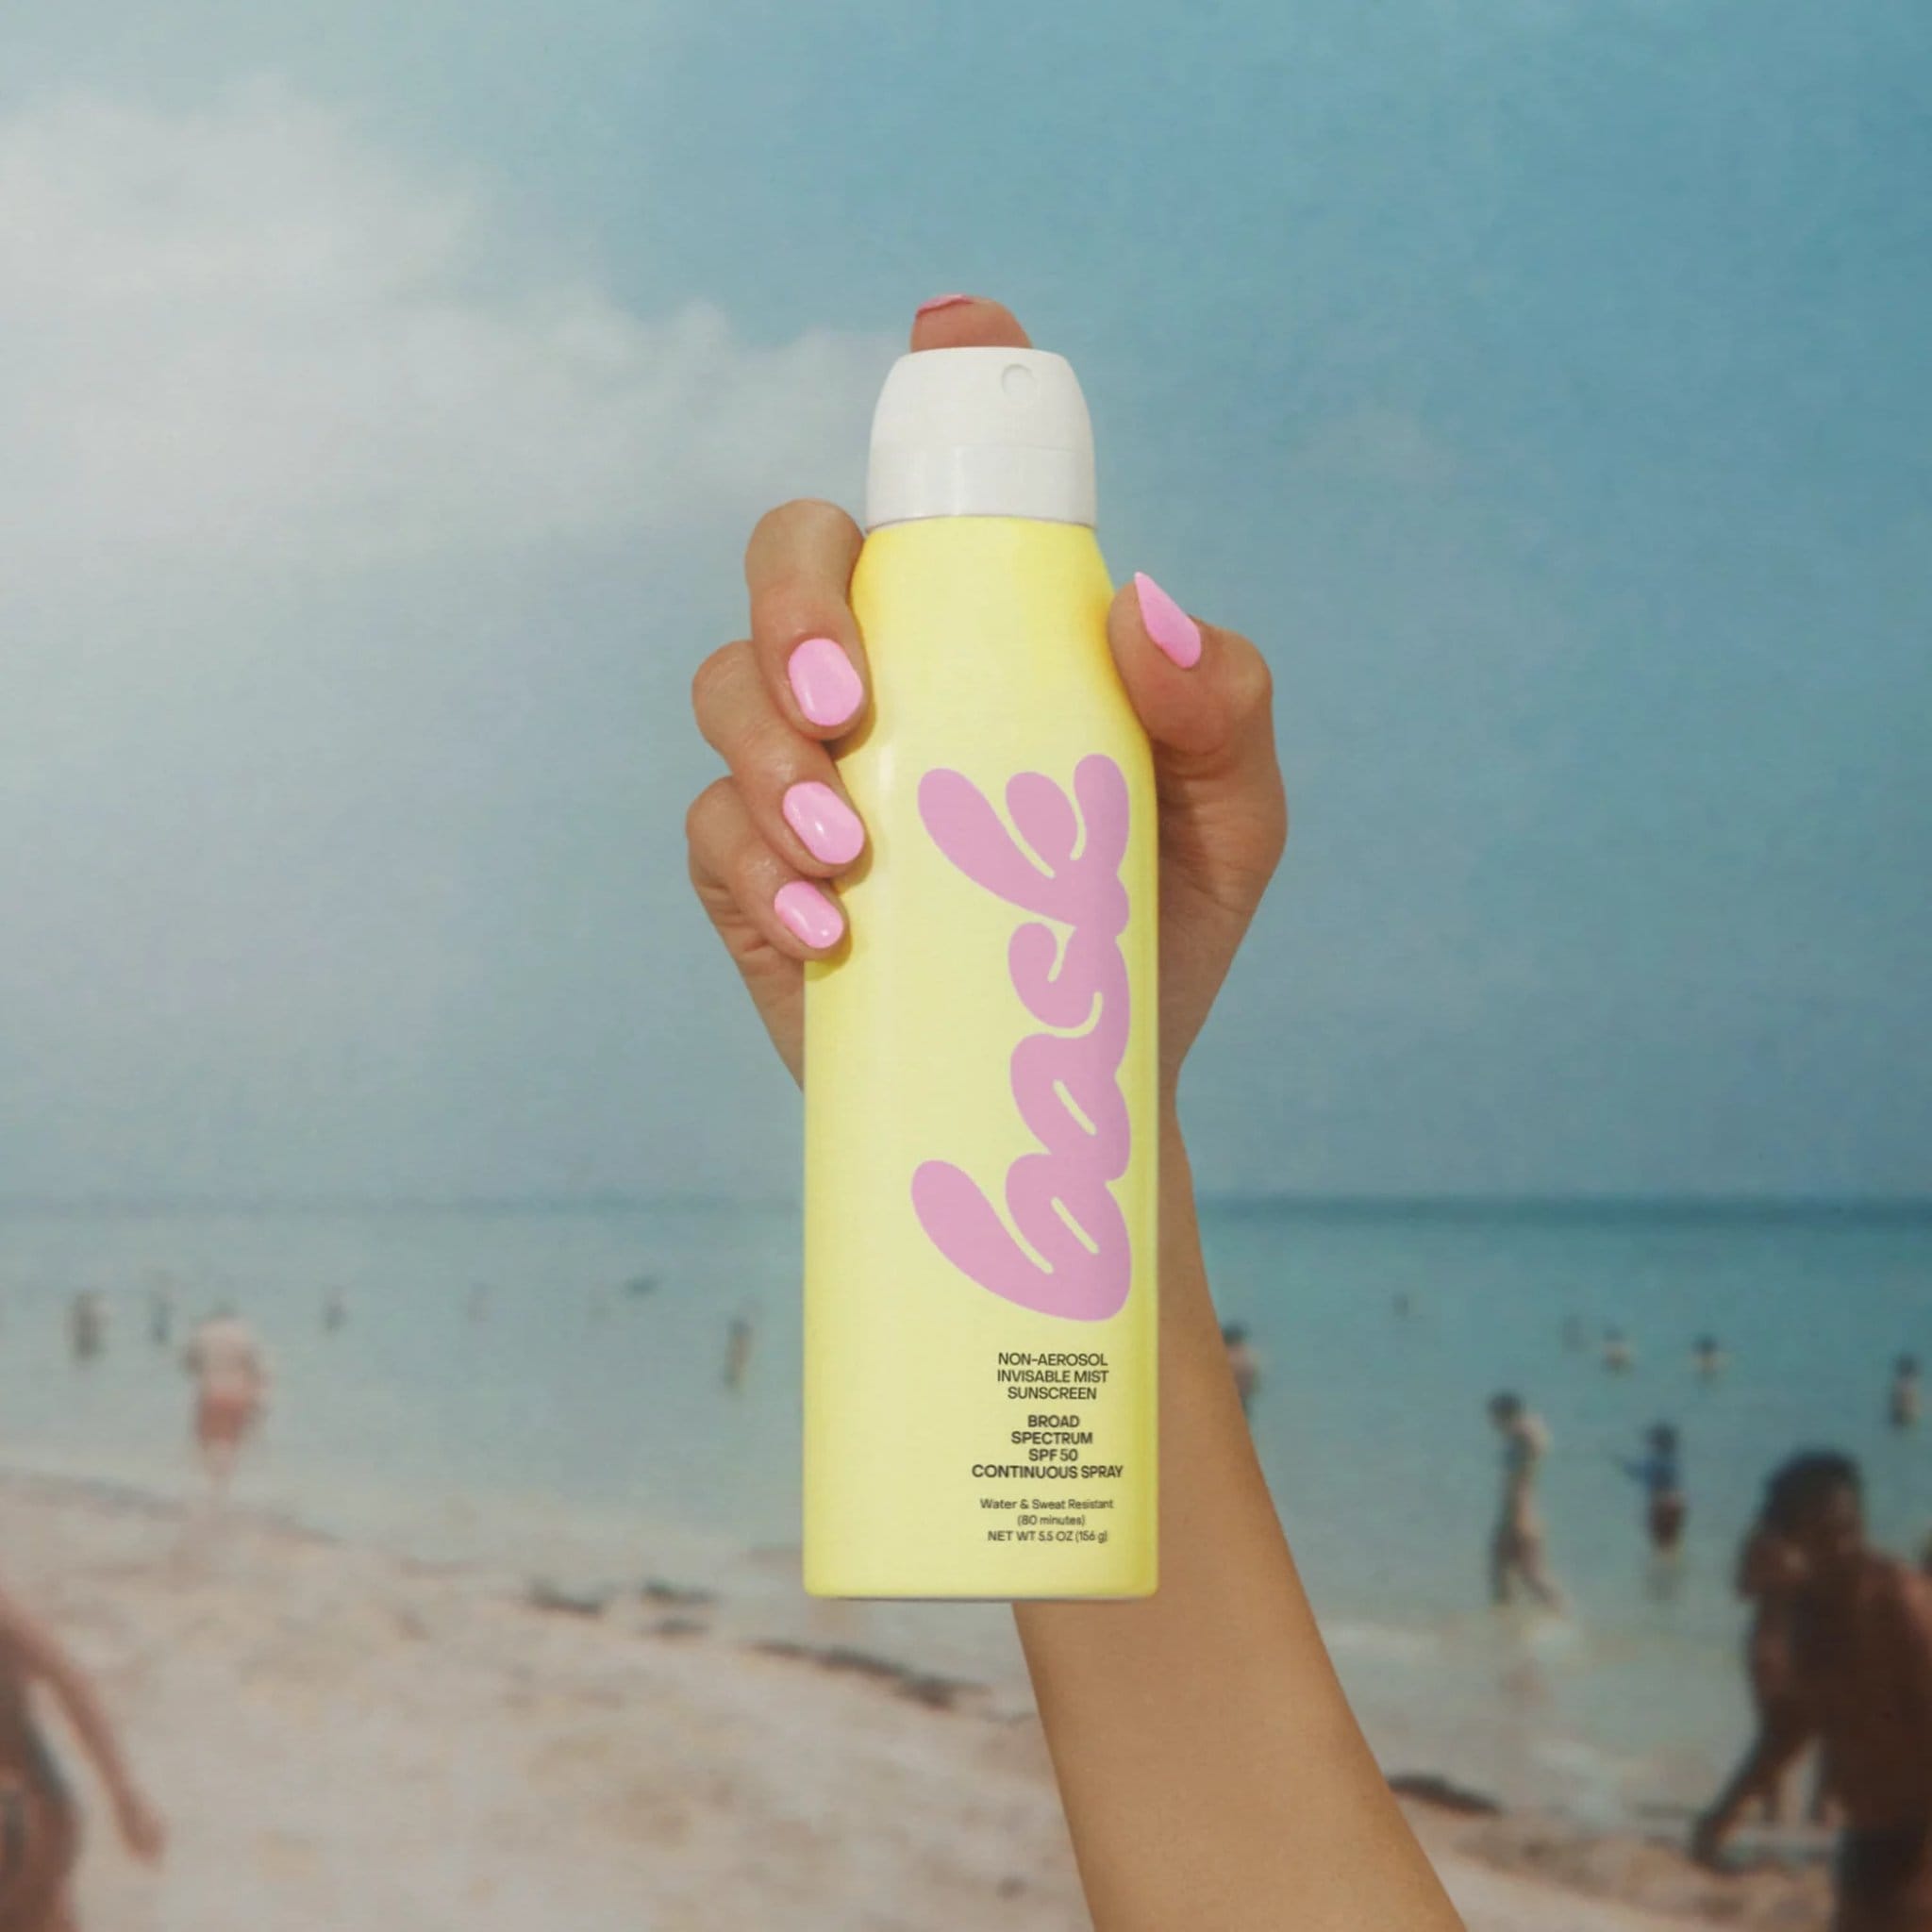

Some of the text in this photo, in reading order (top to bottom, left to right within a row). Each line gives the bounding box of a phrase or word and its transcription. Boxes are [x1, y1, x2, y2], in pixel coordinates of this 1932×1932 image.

[911, 754, 1132, 1322] bask
[998, 1352, 1108, 1367] NON-AEROSOL
[997, 1369, 1109, 1384] INVISABLE MIST
[1007, 1386, 1097, 1400] SUNSCREEN
[1027, 1414, 1081, 1428] BROAD
[1010, 1430, 1093, 1445] SPECTRUM
[1028, 1448, 1078, 1462] SPF 50
[972, 1464, 1124, 1479] CONTINUOUS SPRAY
[979, 1498, 1114, 1510] Water & Sweat Resistant
[1017, 1514, 1086, 1526] (80 minutes)
[987, 1530, 1108, 1544] NET WT 5.5 OZ (156 g)
